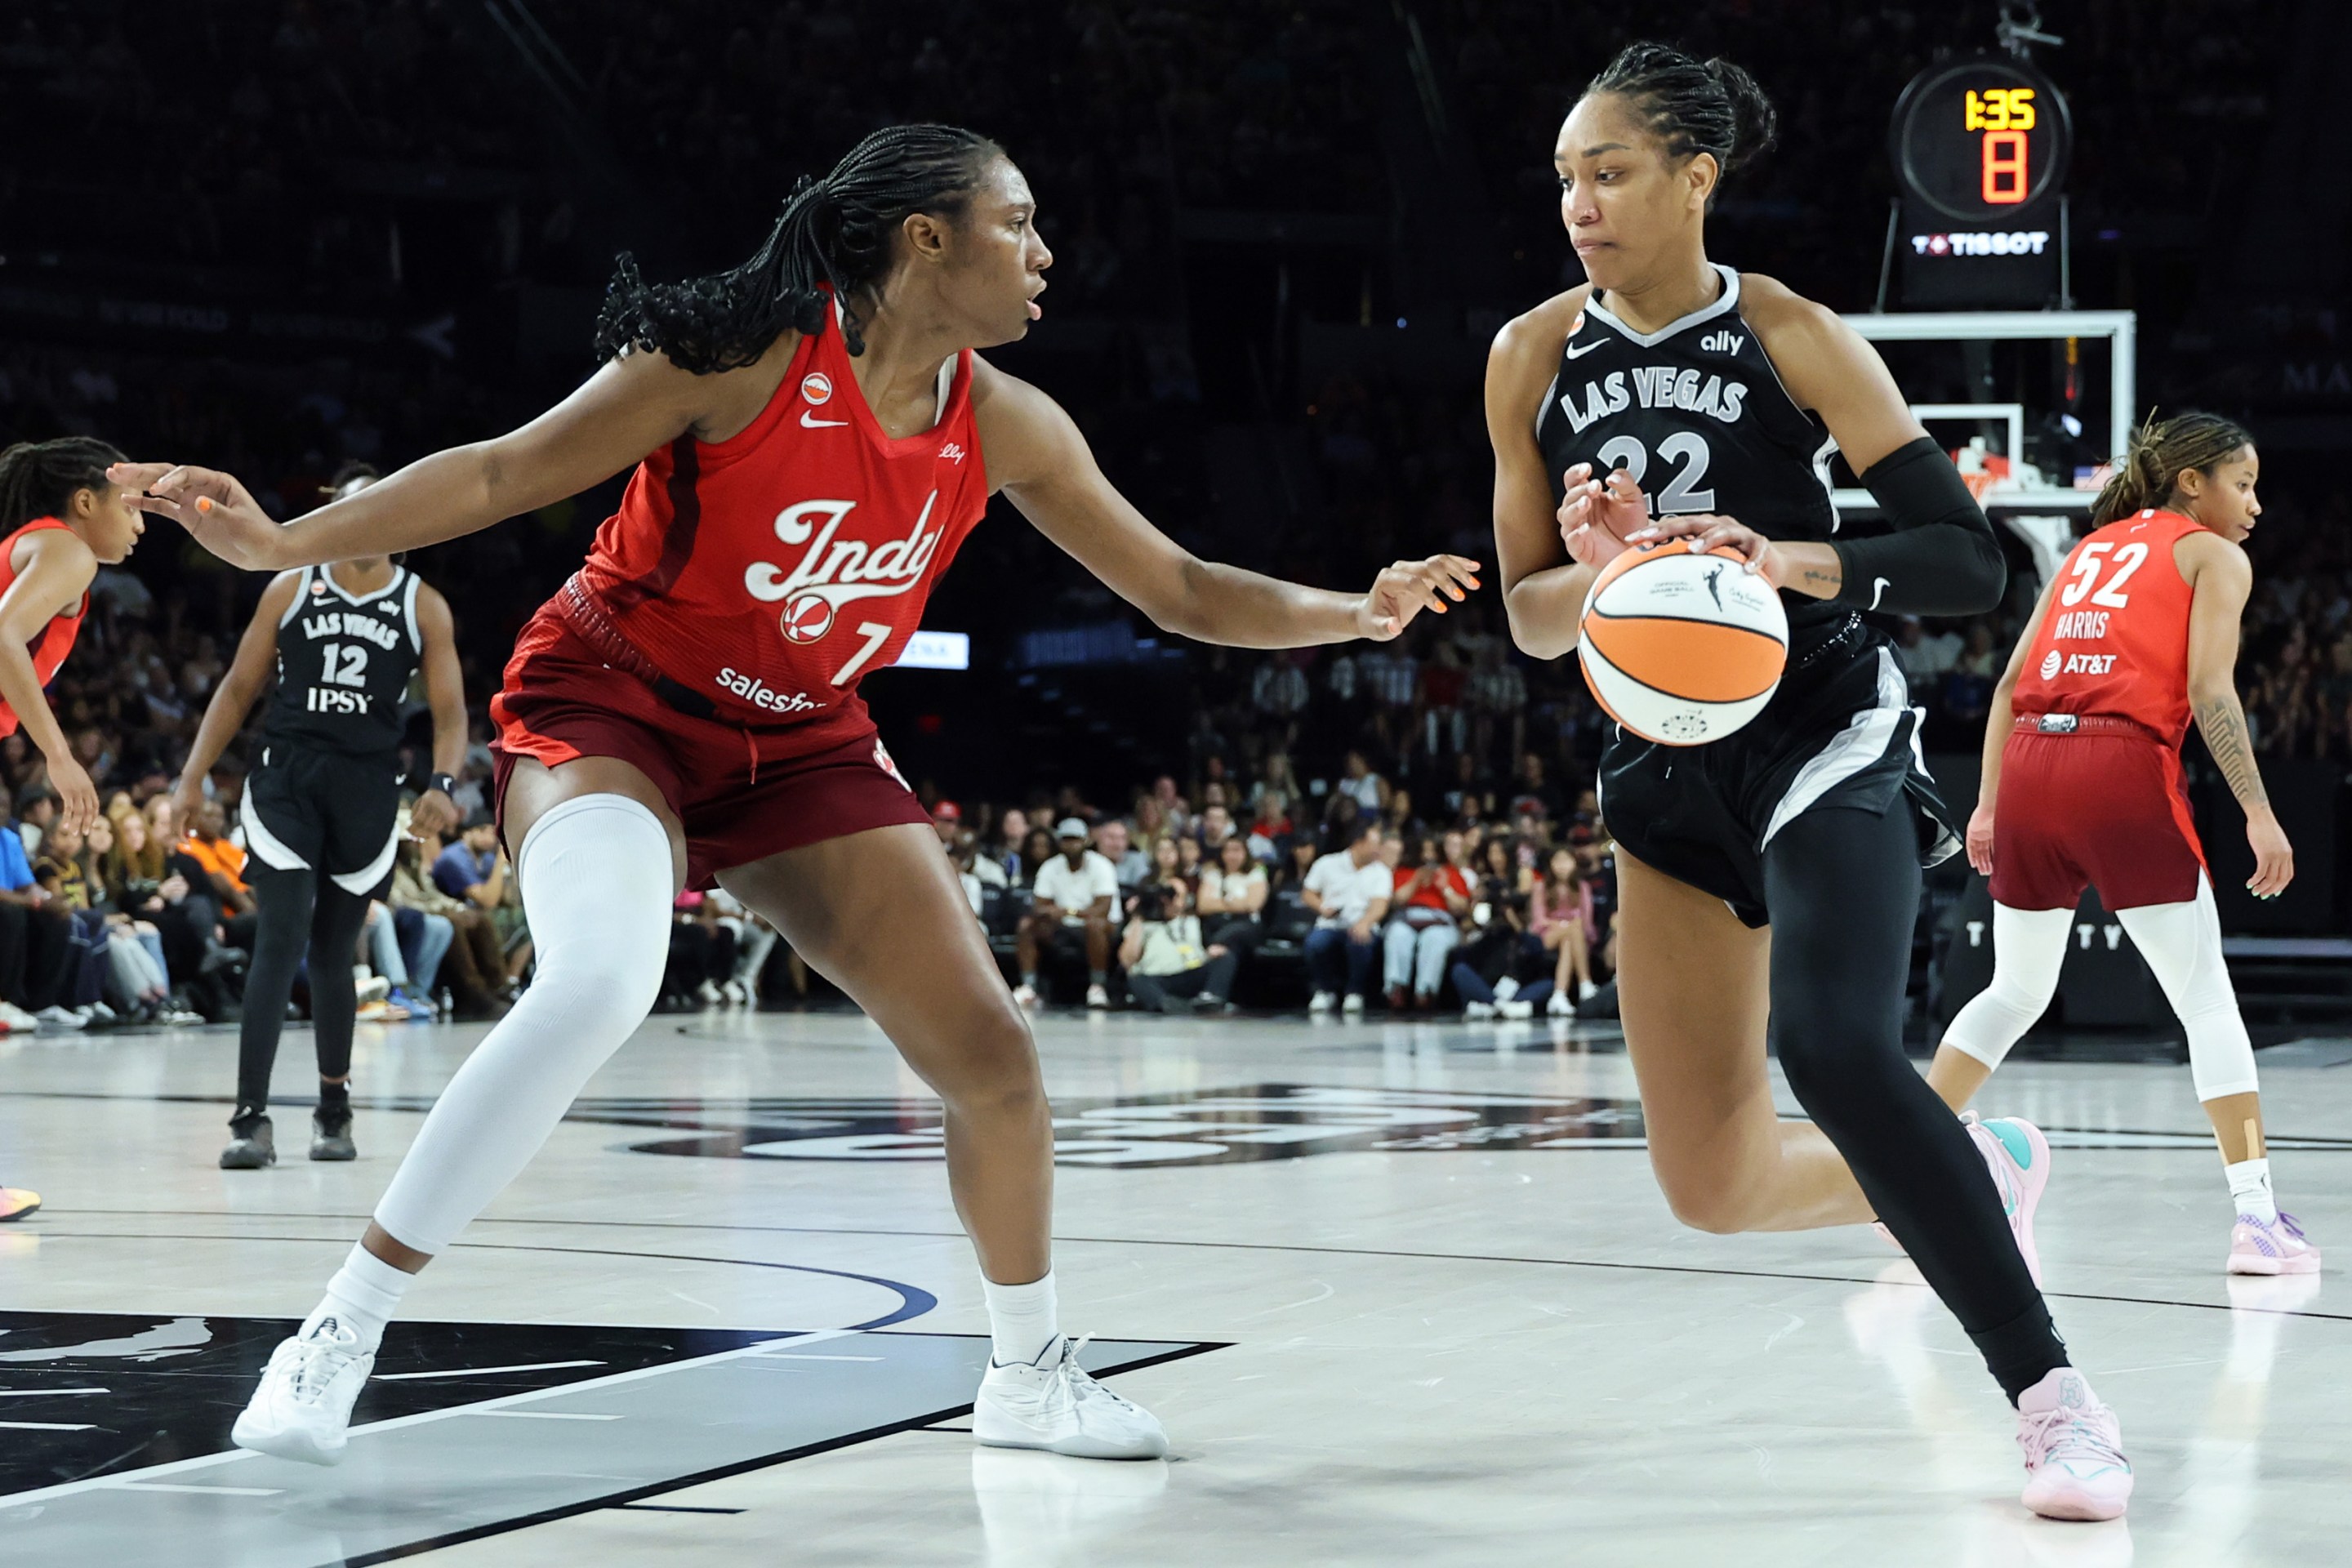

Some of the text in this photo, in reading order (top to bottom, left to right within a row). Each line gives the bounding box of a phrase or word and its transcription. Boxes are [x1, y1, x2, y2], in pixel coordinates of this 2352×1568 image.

[1966, 89, 2034, 131] 1:35
[1982, 130, 2028, 203] 8
[1700, 330, 1744, 356] ally
[1560, 367, 1748, 434] LAS VEGAS
[1597, 431, 1715, 514] 22
[745, 488, 945, 611] Indy
[2060, 542, 2149, 608] 52
[302, 612, 400, 651] LAS VEGAS
[2053, 611, 2110, 640] HARRIS
[321, 642, 369, 688] 12
[831, 621, 893, 686] 7
[2063, 653, 2117, 675] AT&T
[307, 687, 374, 715] IPSY
